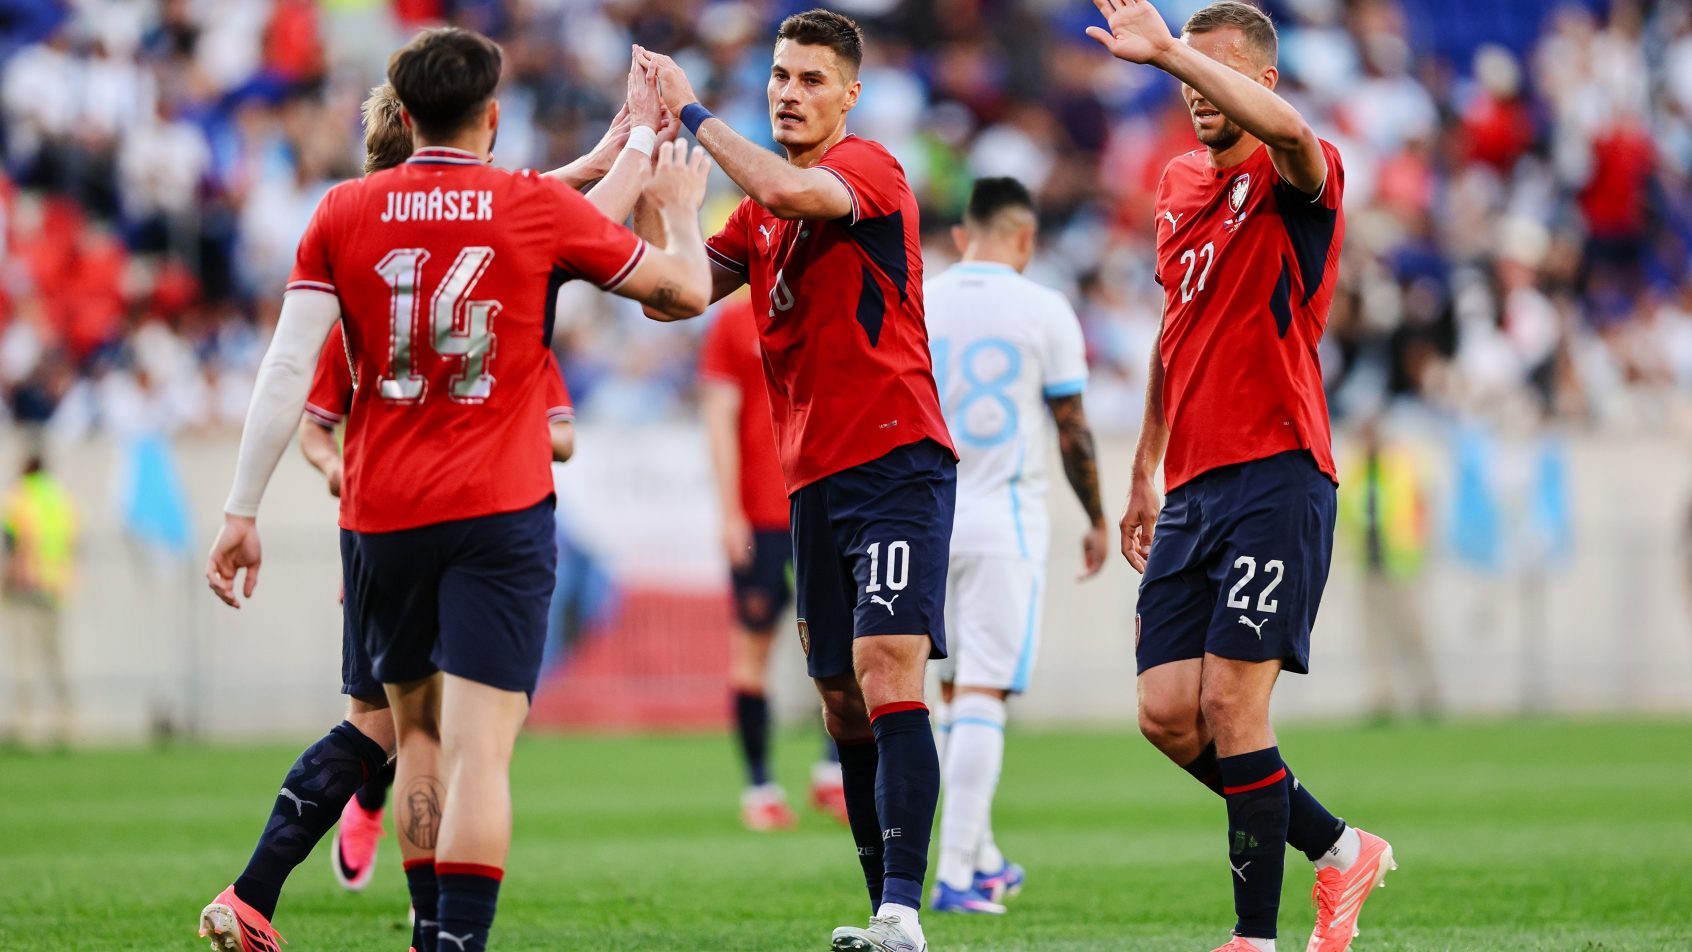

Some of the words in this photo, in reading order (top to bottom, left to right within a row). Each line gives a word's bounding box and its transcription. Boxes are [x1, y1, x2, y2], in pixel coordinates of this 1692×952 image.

[380, 187, 493, 223] JURÁSEK
[374, 246, 503, 405] 14
[866, 540, 910, 593] 10
[1227, 556, 1285, 613] 22
